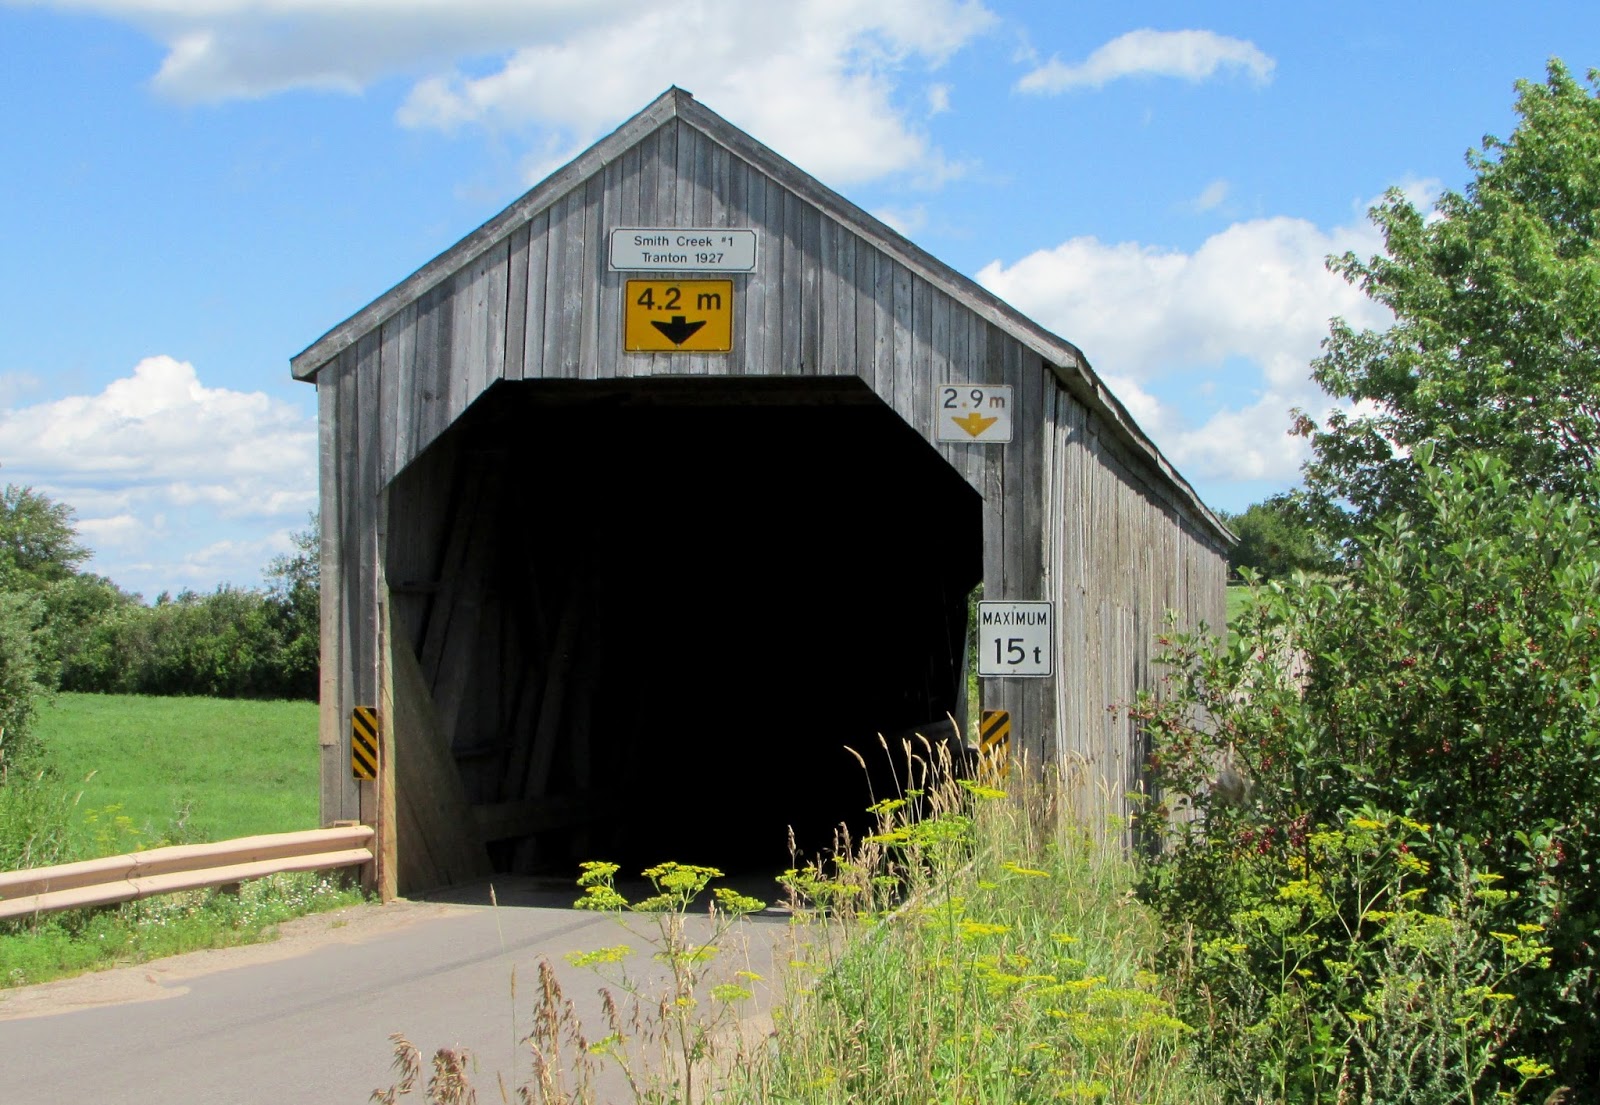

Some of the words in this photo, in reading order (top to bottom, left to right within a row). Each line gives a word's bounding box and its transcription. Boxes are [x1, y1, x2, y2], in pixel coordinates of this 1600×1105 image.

[634, 235, 669, 247] Smith
[676, 235, 713, 247] Creek
[721, 236, 734, 247] #1
[642, 252, 688, 263] Tranton
[695, 253, 724, 264] 1927
[637, 287, 682, 310] 4.2
[697, 293, 721, 310] m
[943, 388, 984, 409] 2.9
[989, 396, 1006, 408] m
[983, 612, 1047, 626] MAXIMUM
[994, 638, 1026, 665] 15
[1032, 646, 1042, 664] t
